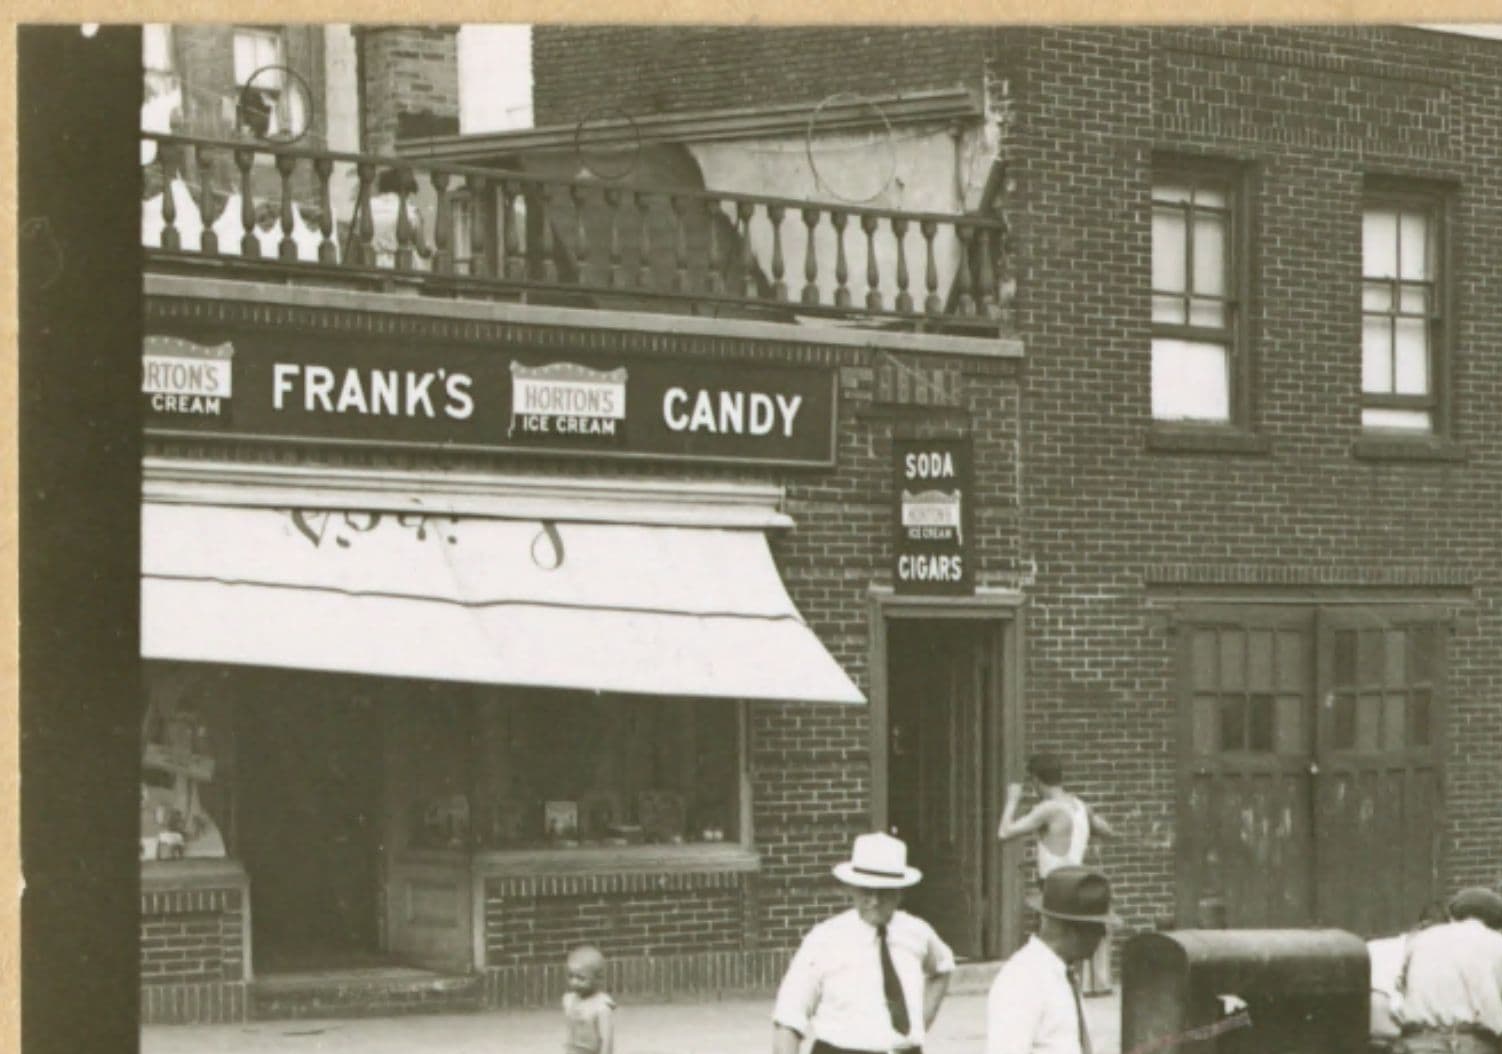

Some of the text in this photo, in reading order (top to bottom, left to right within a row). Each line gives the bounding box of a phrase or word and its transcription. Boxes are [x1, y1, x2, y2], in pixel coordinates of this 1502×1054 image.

[143, 360, 219, 392] RTON'S
[151, 393, 220, 415] CREAM
[272, 361, 475, 420] FRANK'S
[524, 383, 615, 413] HORTON'S
[523, 416, 615, 435] ICE CREAM
[662, 387, 802, 437] CANDY
[905, 452, 954, 479] SODA
[898, 555, 963, 581] CIGARS
